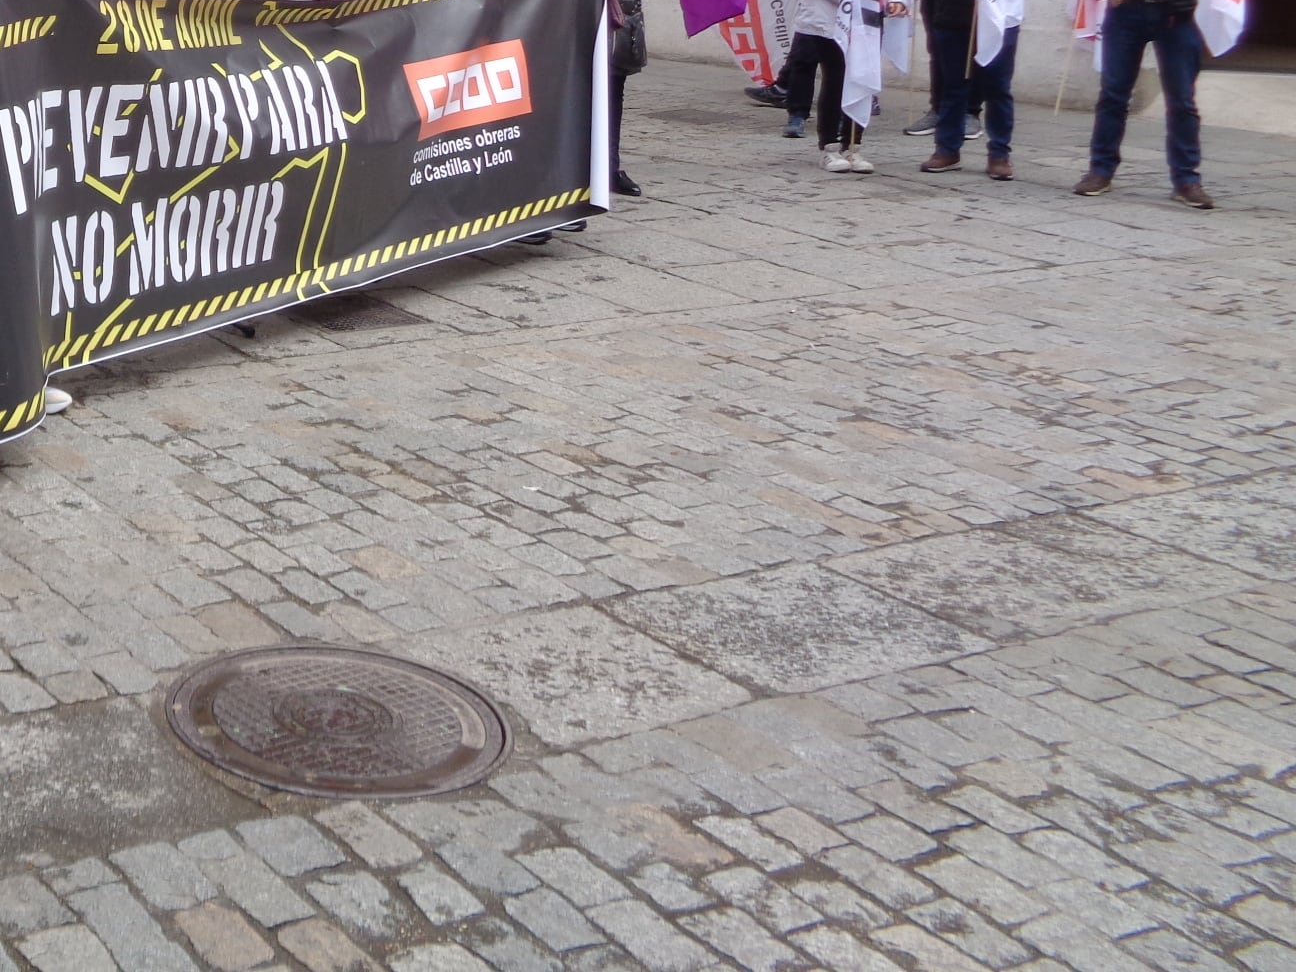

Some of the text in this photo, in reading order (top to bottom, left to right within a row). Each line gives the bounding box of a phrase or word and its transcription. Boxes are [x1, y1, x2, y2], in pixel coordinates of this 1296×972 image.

[97, 0, 140, 54] 28
[135, 0, 174, 51] DE
[227, 60, 348, 160] PARA
[416, 57, 523, 123] CCOO
[409, 147, 513, 185] de Castilla y León
[413, 125, 521, 163] comisiones obreras
[50, 180, 284, 316] NO MORIR
